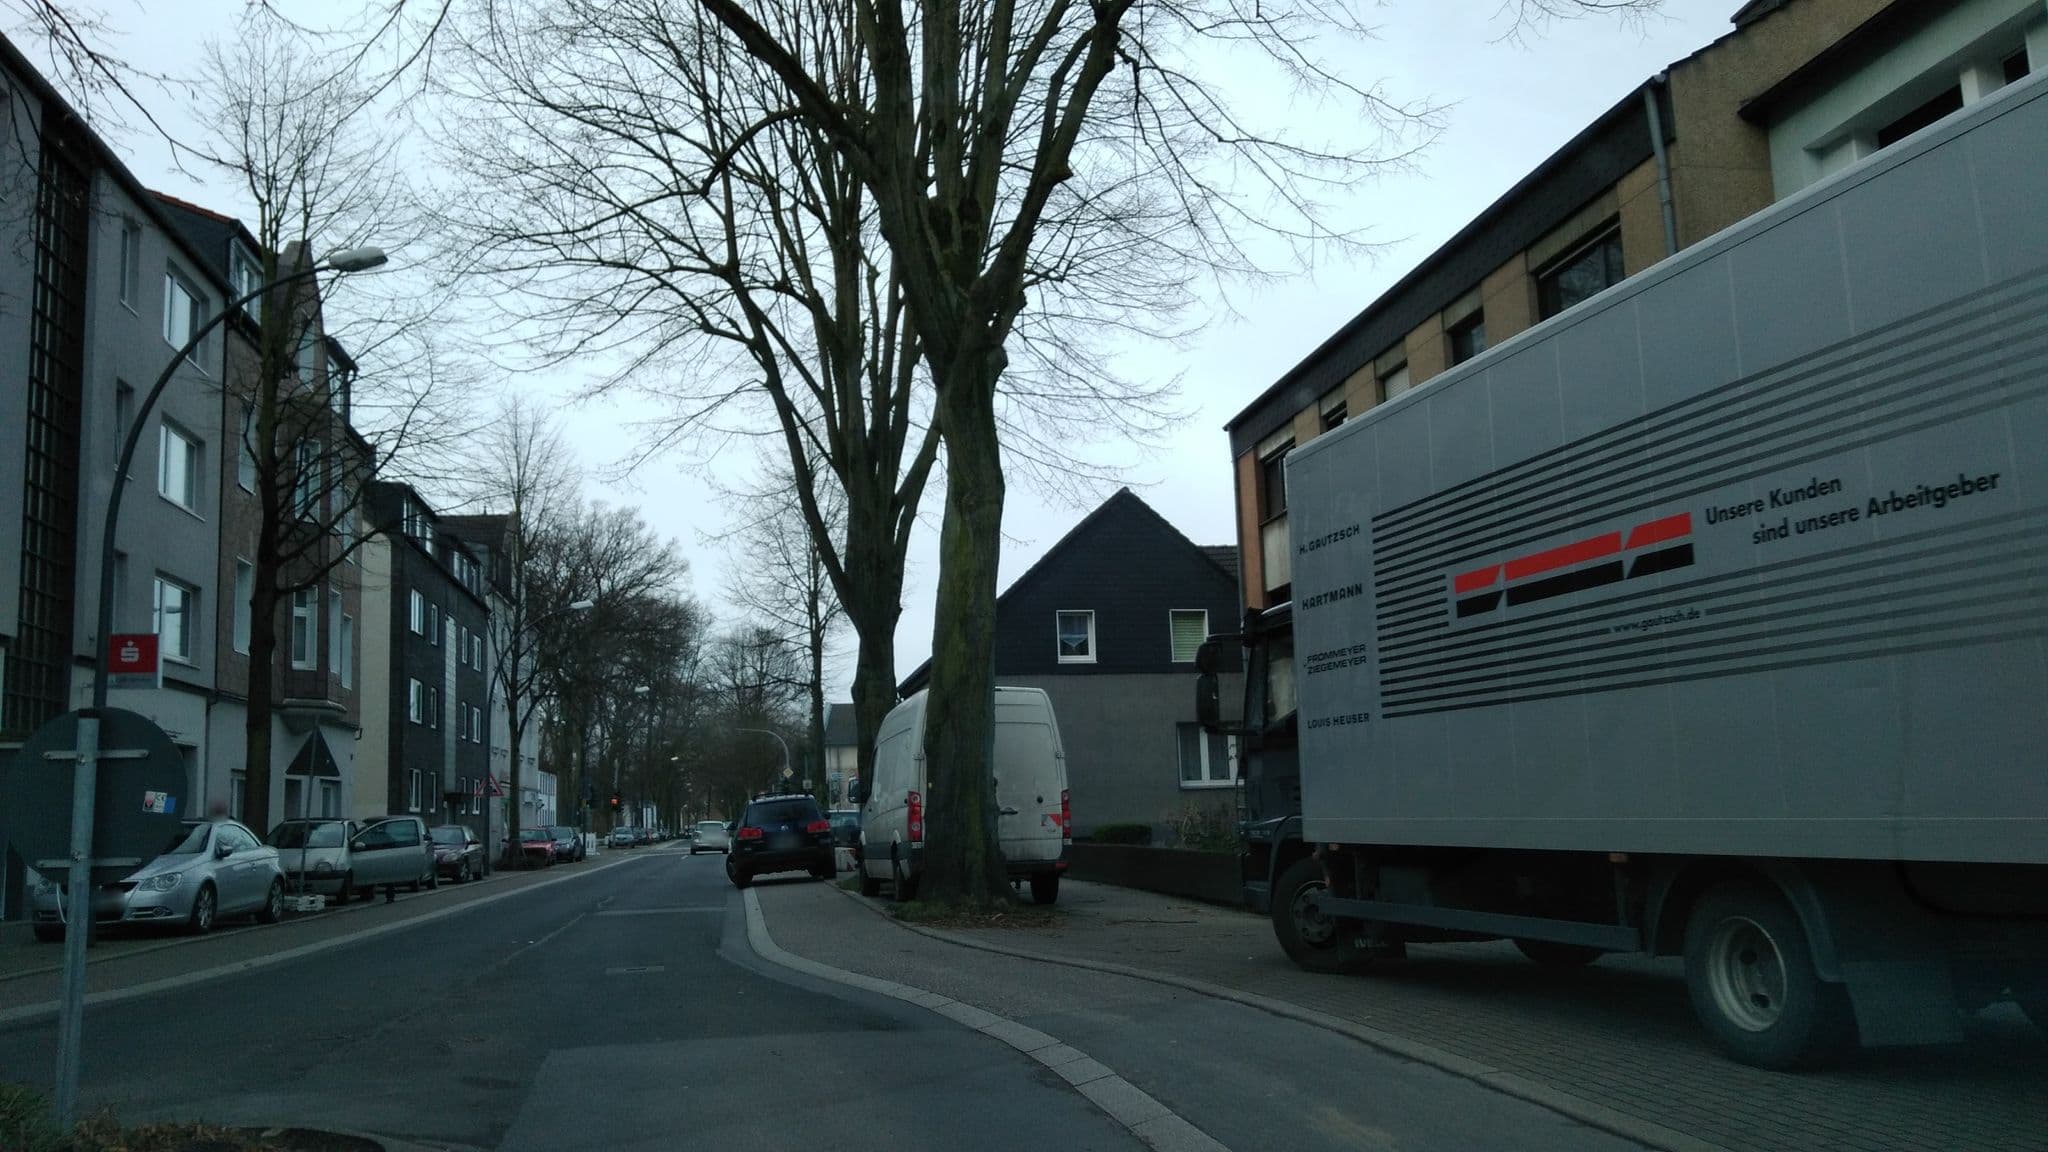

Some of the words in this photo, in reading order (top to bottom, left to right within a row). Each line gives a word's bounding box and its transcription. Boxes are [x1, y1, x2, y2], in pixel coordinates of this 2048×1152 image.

[1705, 499, 1764, 525] Unsere
[1769, 477, 1842, 509] Kunden
[1752, 517, 1789, 545] sind
[1795, 506, 1860, 535] unsere
[1866, 472, 2001, 518] Arbeitgeber
[1302, 583, 1363, 611] HARTMANN
[1306, 643, 1366, 664] FROMMEYER
[1307, 717, 1331, 729] LOUIS
[1333, 712, 1370, 726] HEUSER
